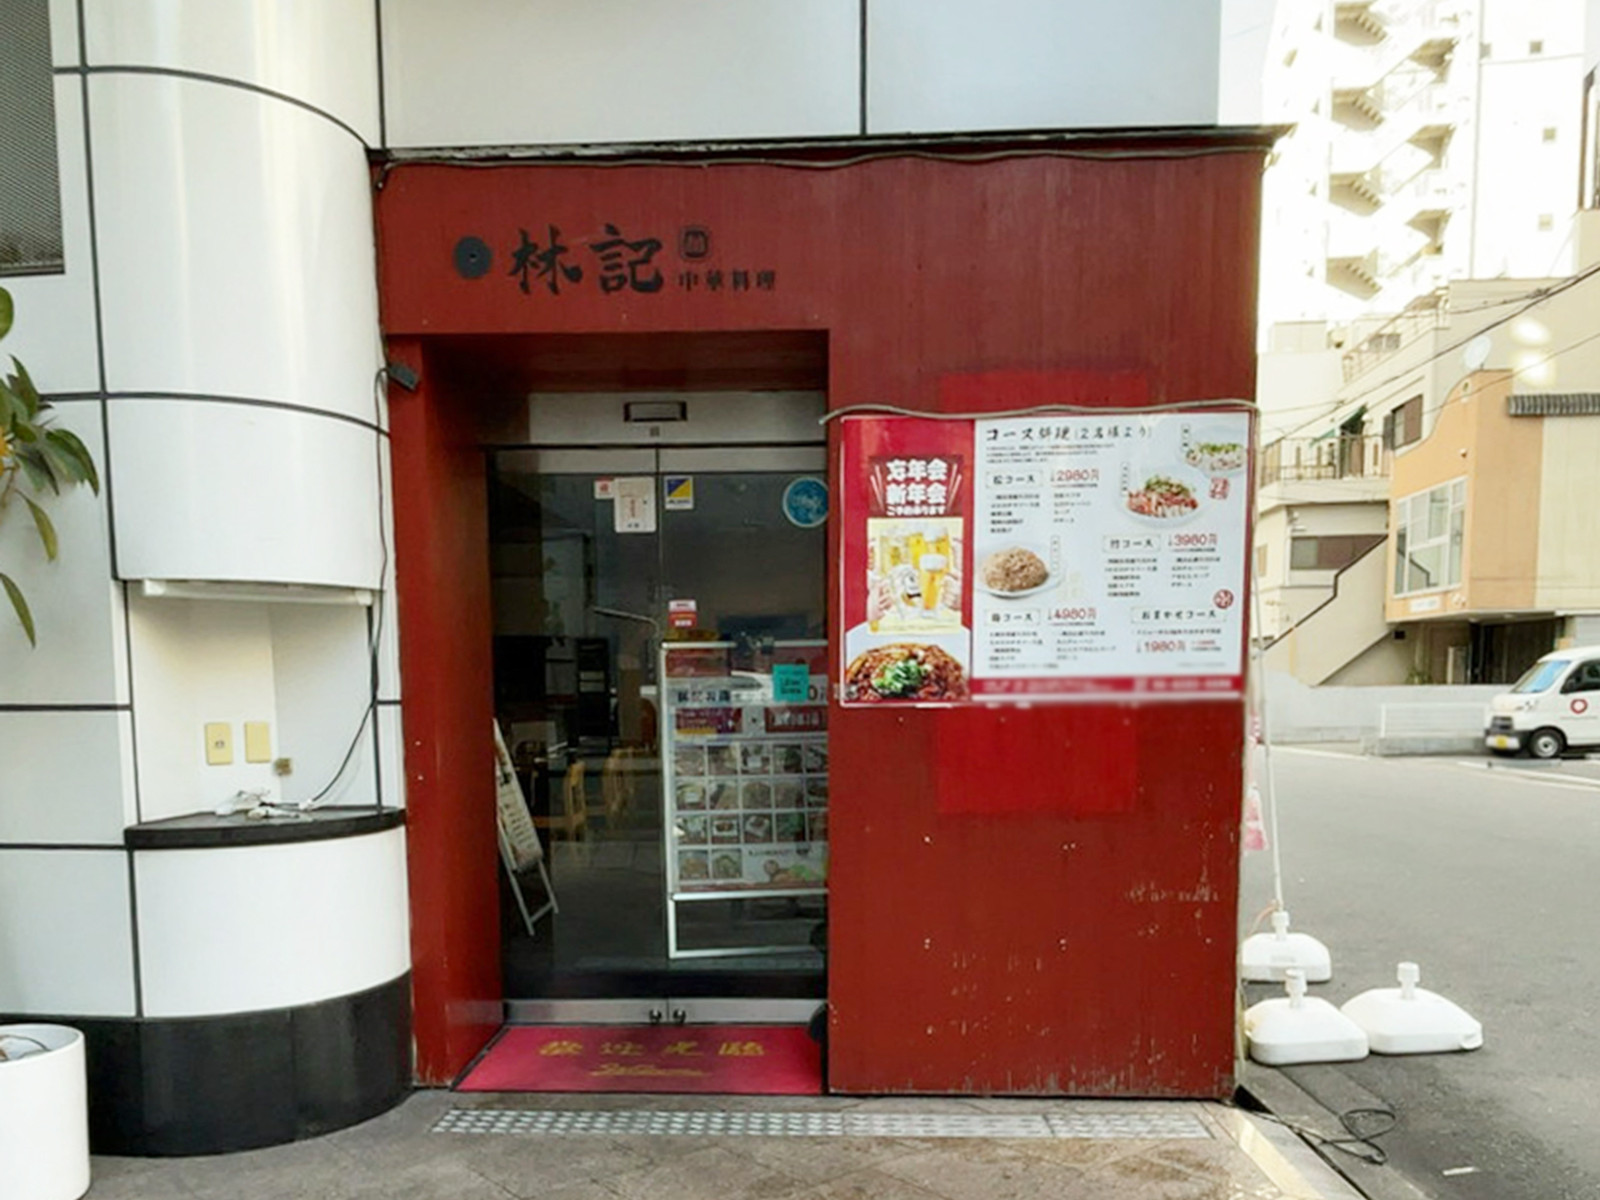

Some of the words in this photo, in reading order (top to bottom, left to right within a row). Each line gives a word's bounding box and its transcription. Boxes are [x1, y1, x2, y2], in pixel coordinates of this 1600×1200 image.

[509, 223, 663, 295] 林記
[679, 269, 776, 292] 中華料理
[886, 458, 947, 481] 忘年会
[886, 483, 947, 505] 新年会
